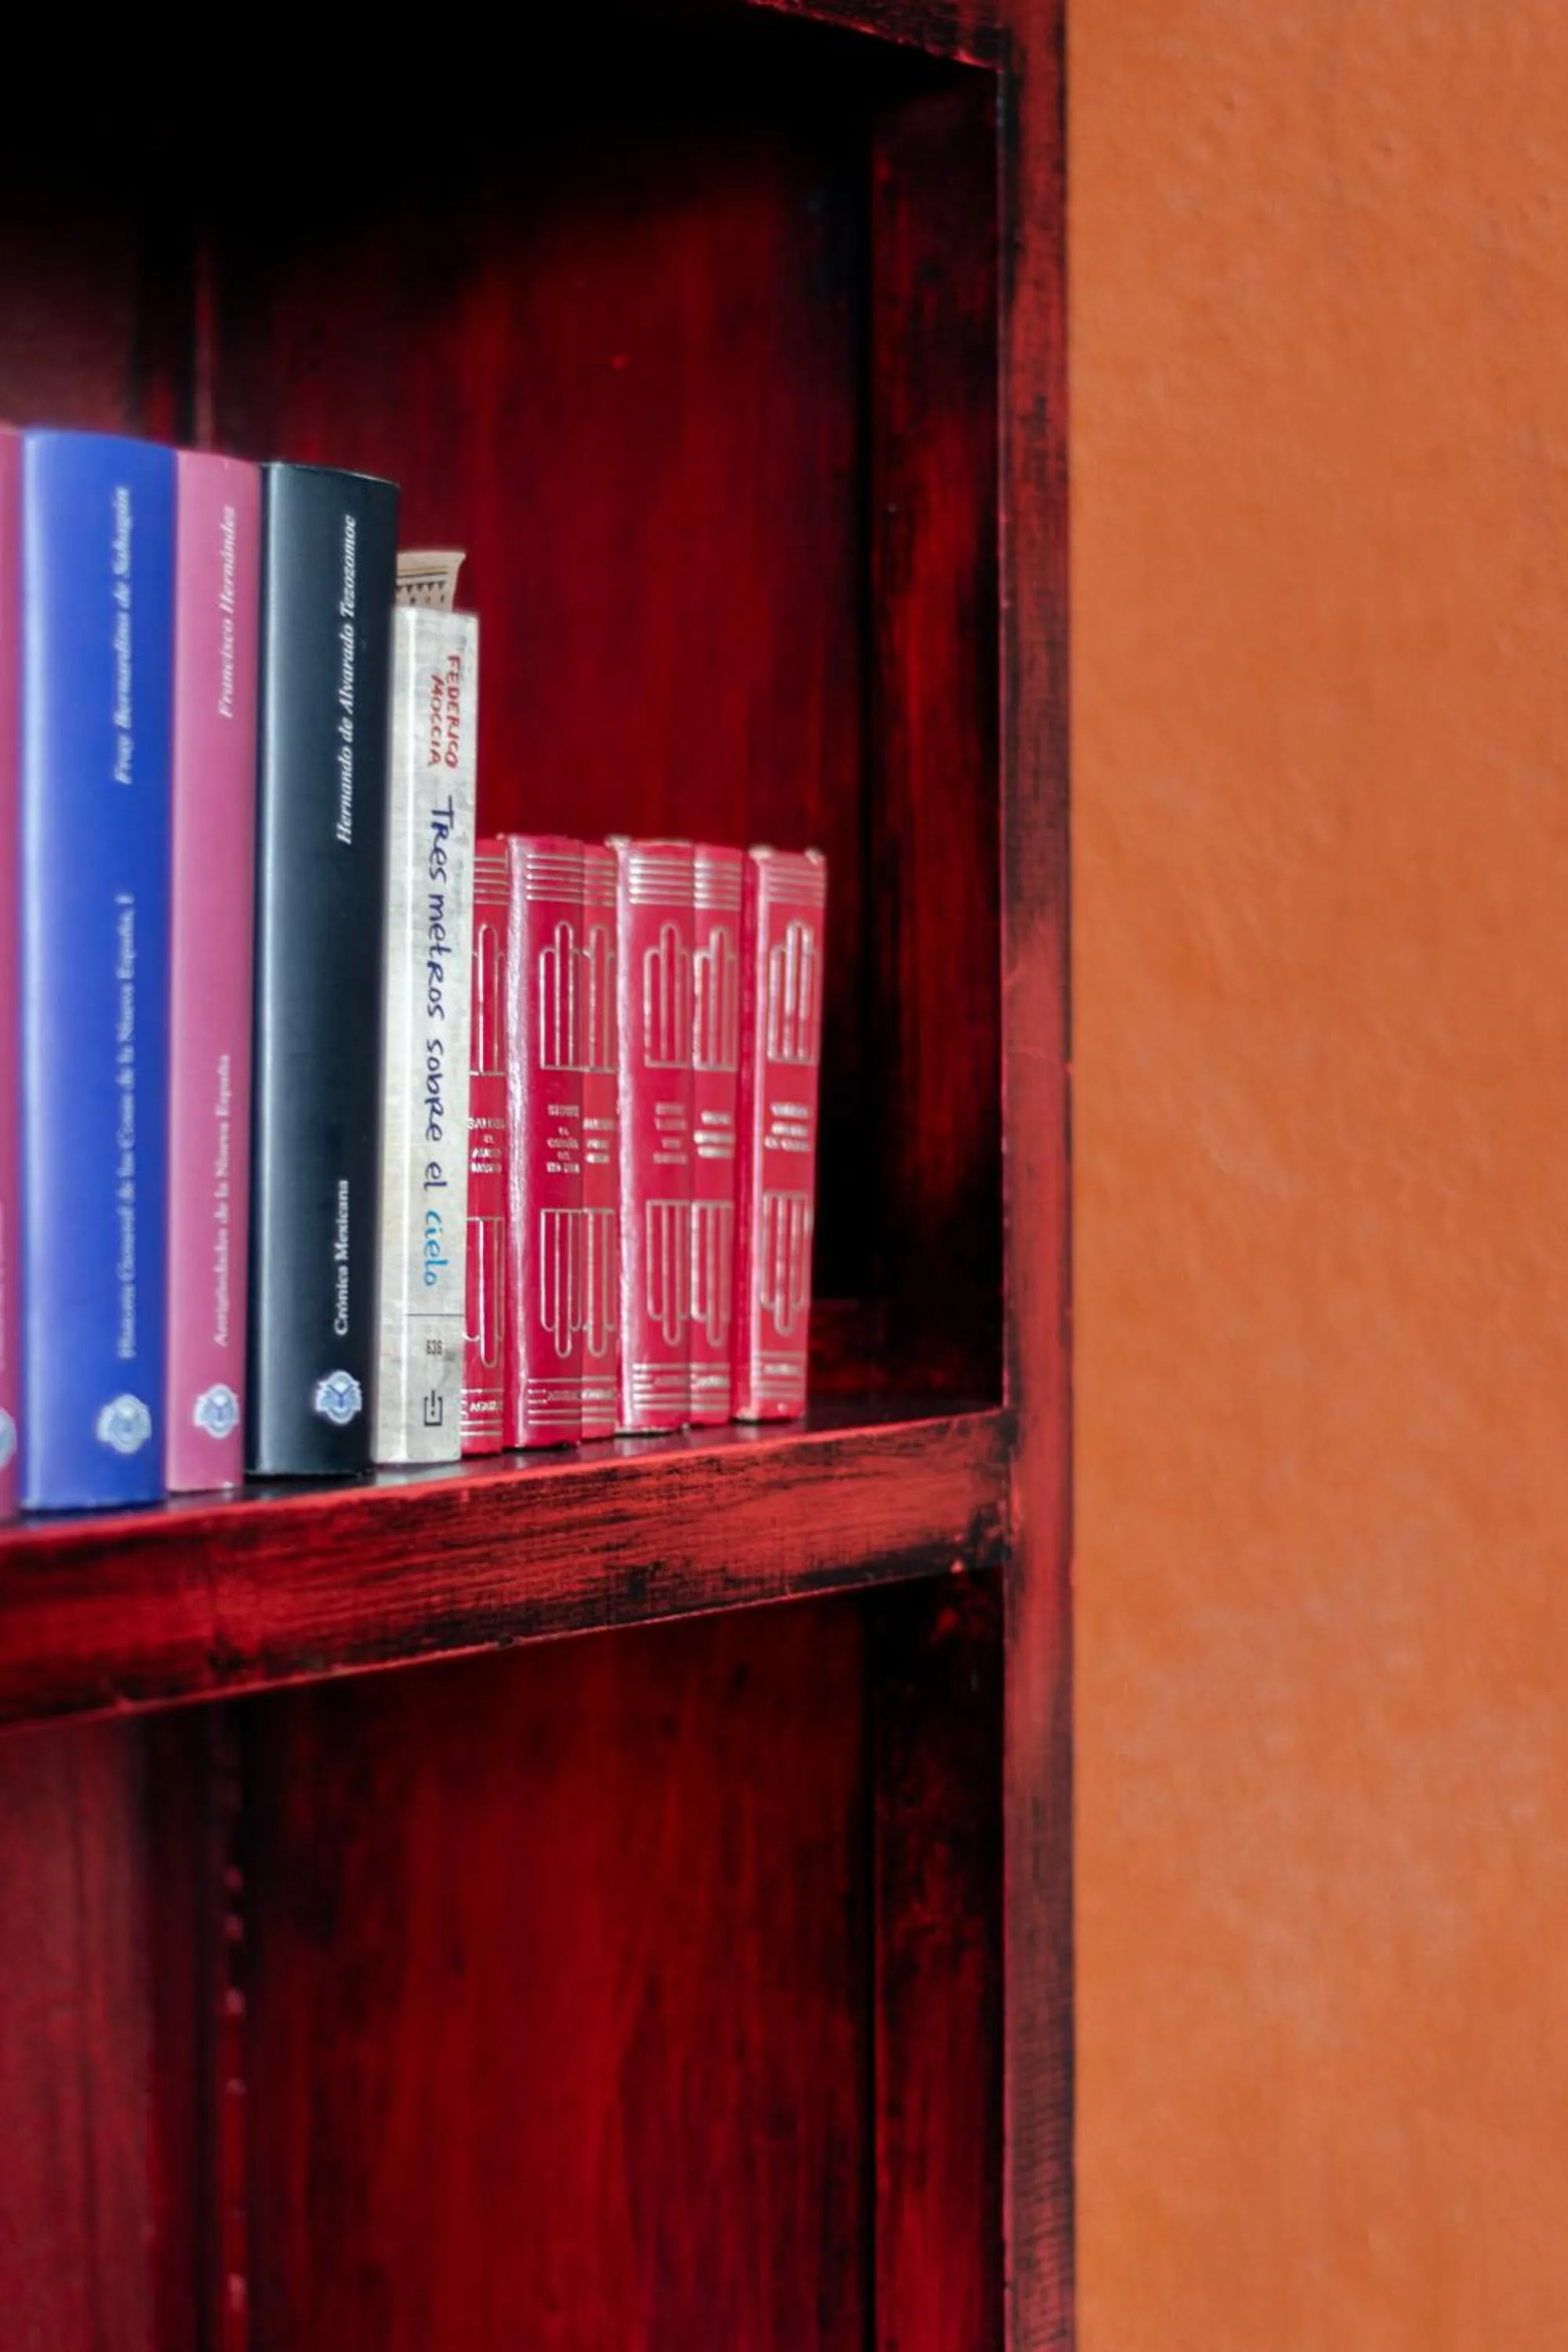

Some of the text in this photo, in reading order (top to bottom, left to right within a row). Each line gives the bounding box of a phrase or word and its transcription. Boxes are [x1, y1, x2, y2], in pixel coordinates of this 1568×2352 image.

[220, 506, 235, 719] Francisco Hernández
[337, 516, 357, 844] Hernando de Alvarado Tezozomoc
[428, 675, 447, 768] MOCCIA
[442, 655, 461, 769] FEDERICO
[424, 1160, 448, 1192] el
[335, 1181, 349, 1337] Crónica Mexicana
[424, 1208, 449, 1290] cielo
